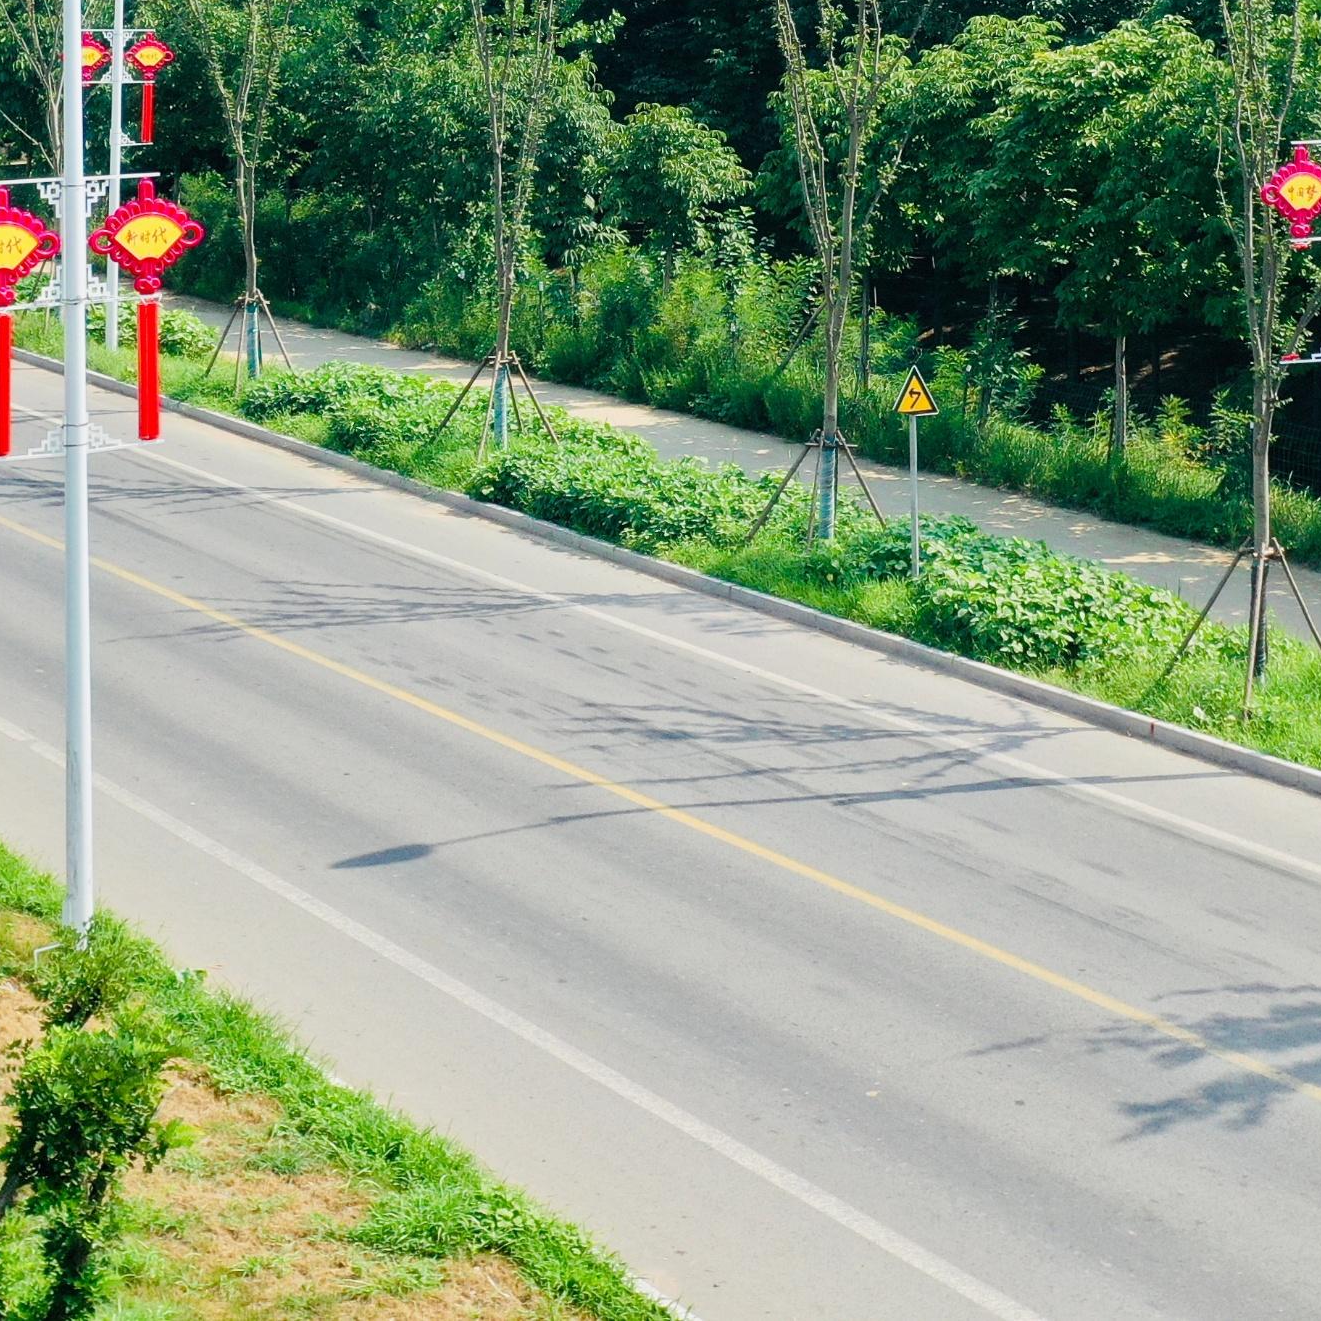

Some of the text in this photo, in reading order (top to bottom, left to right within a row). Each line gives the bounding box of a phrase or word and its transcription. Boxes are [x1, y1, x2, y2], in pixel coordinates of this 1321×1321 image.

[1288, 184, 1317, 202] 中国梦
[126, 227, 168, 245] 新时代
